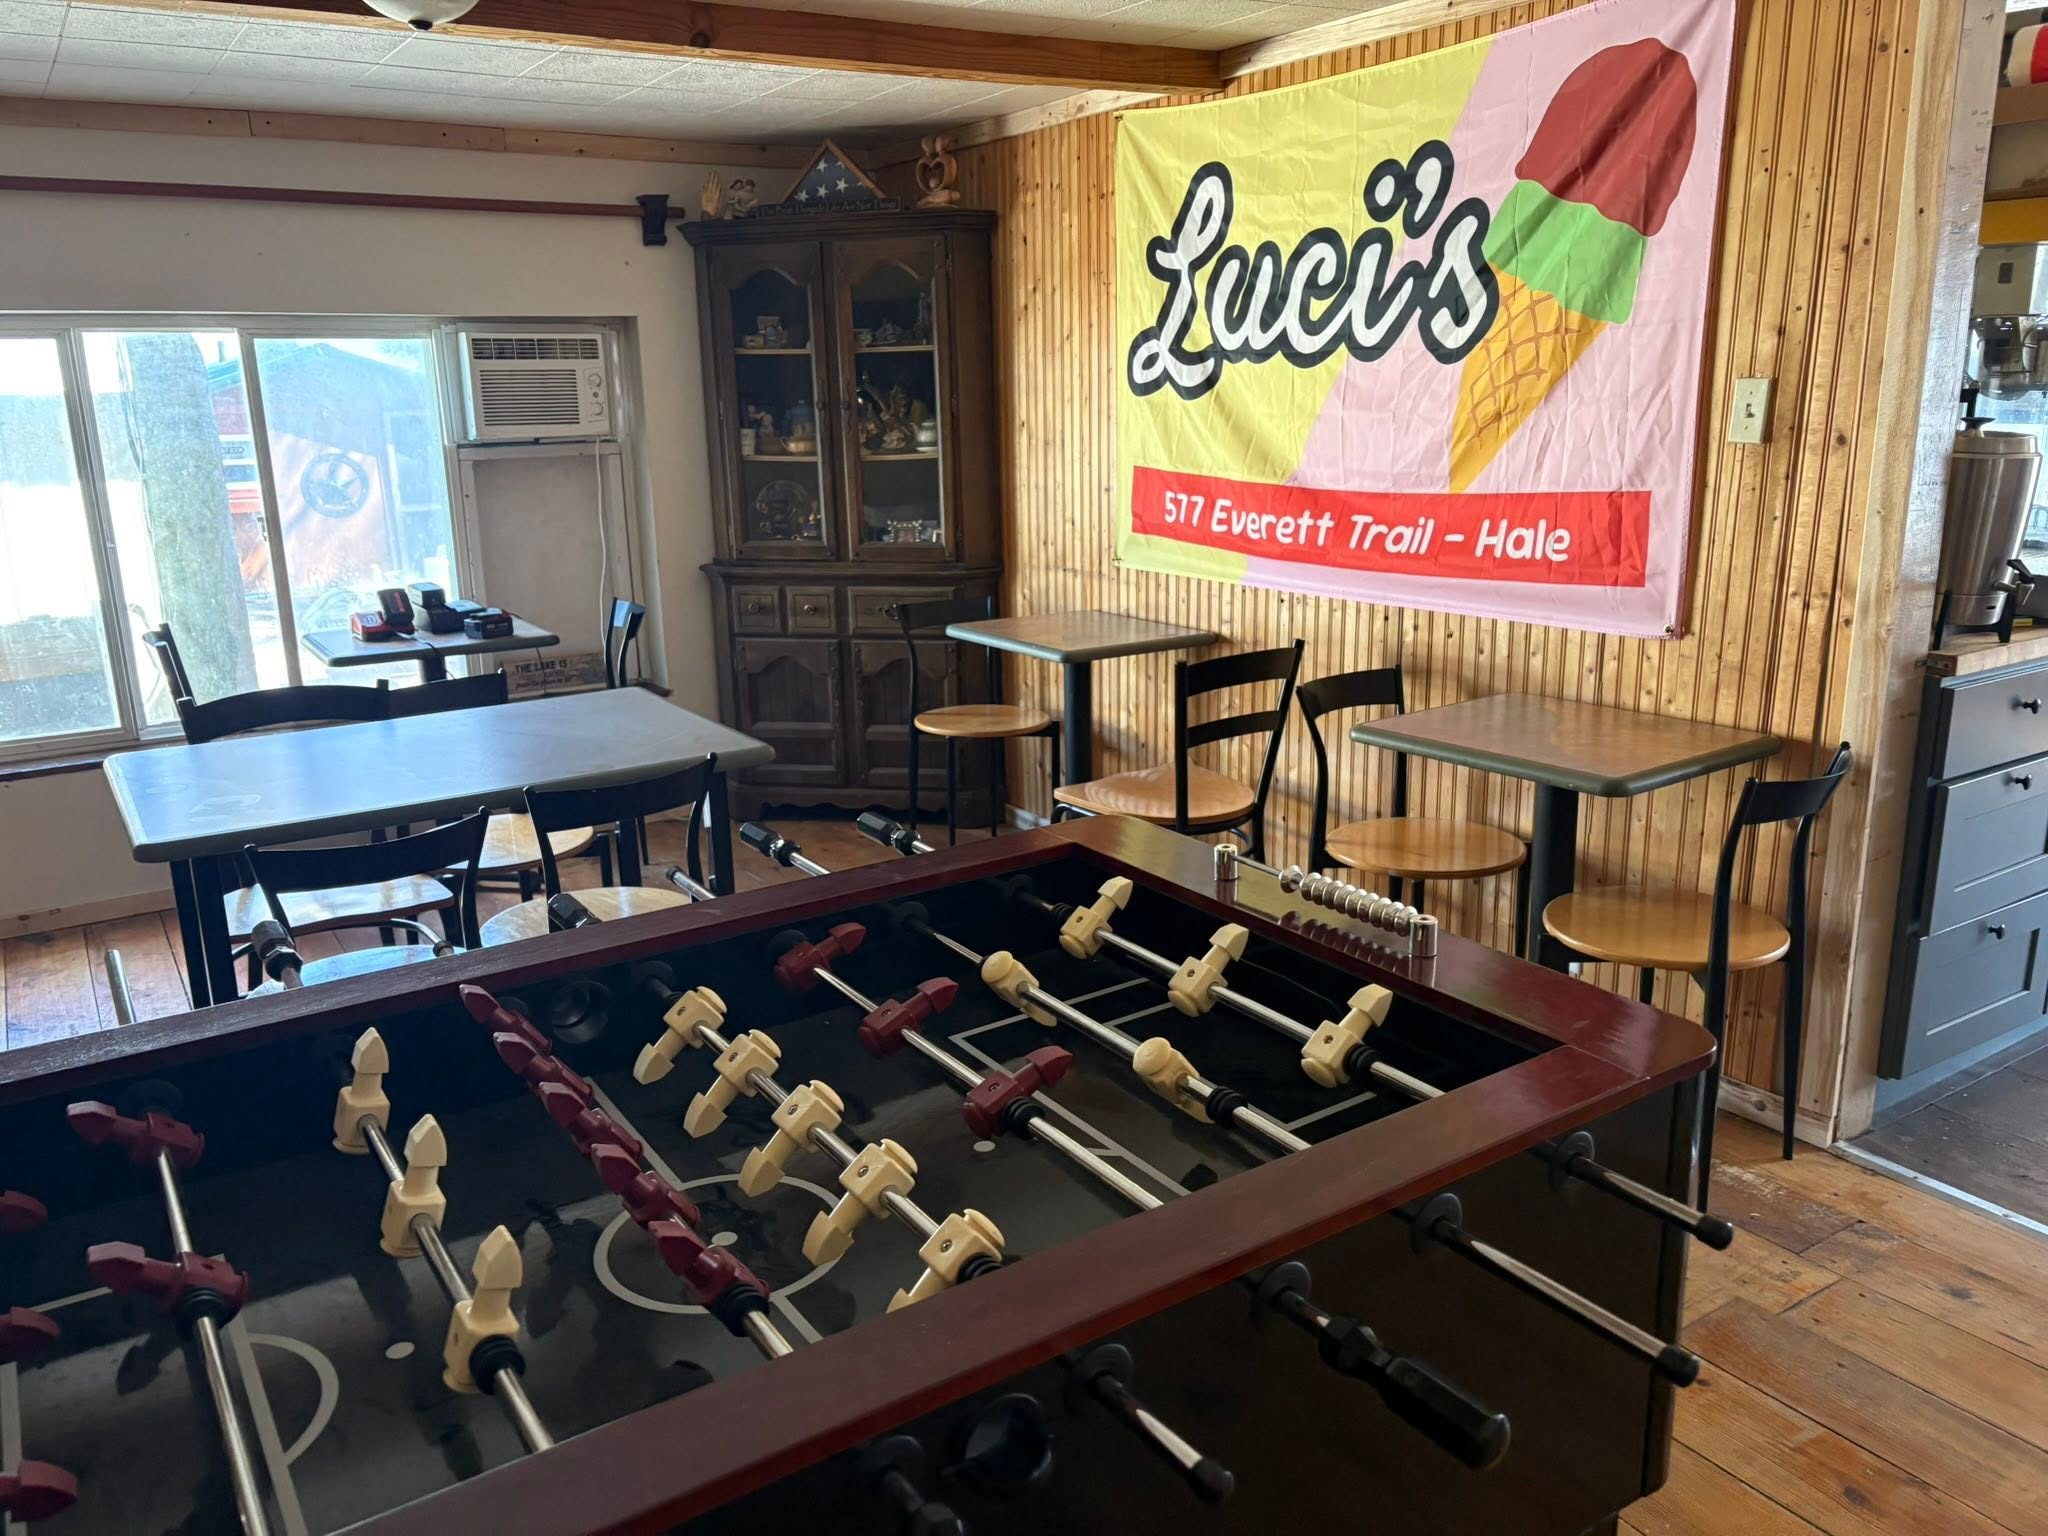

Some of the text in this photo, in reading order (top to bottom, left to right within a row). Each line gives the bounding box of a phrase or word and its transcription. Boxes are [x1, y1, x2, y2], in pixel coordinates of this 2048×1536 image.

[1127, 139, 1500, 401] Luci's
[1164, 491, 1572, 562] 577 Everett Trail - Hale
